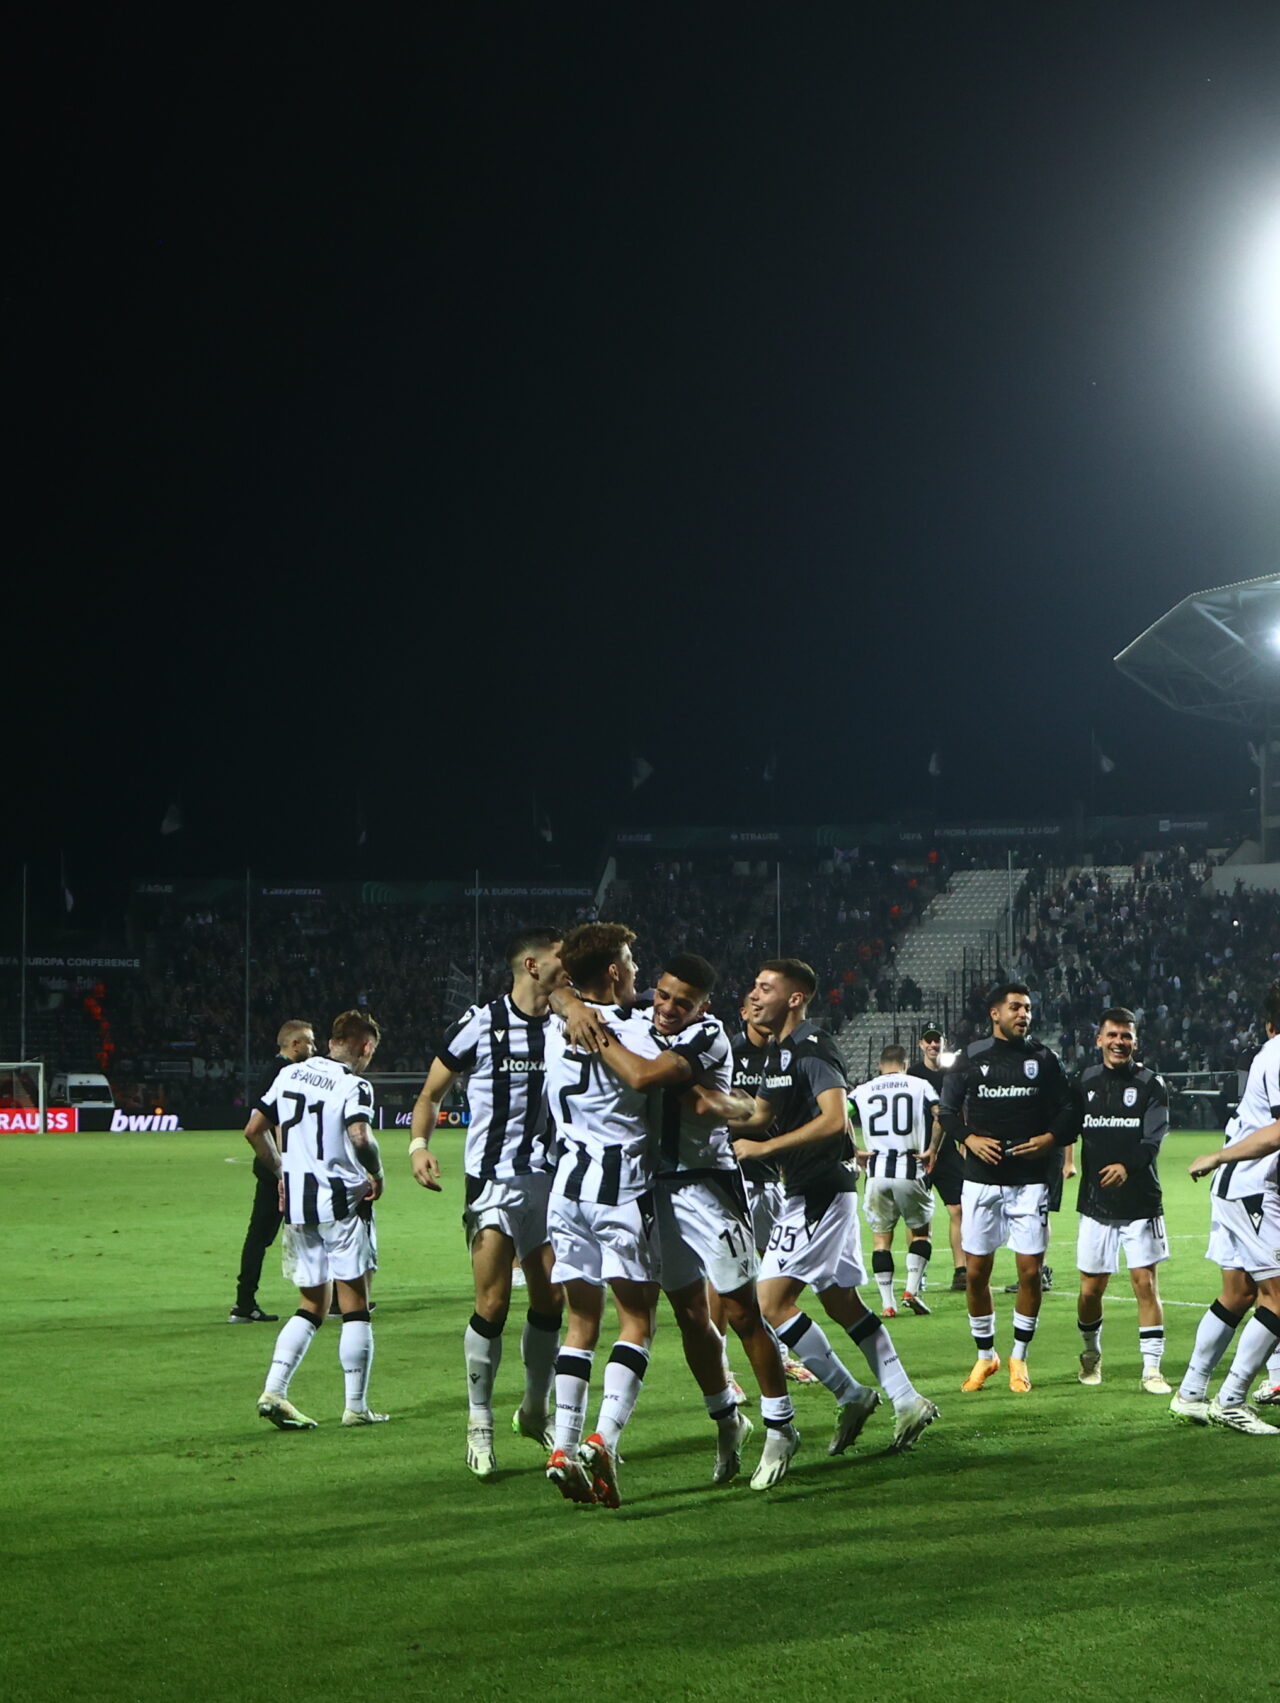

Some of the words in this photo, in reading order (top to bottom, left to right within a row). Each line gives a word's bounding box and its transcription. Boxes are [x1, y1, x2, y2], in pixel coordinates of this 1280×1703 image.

[66, 957, 141, 968] CONFERENCE
[499, 1059, 547, 1072] Stoixi
[110, 1107, 180, 1132] bwin
[281, 1090, 325, 1160] 71
[868, 1093, 913, 1136] 20
[1082, 1113, 1141, 1129] Stoiximan
[718, 1223, 747, 1259] 11
[768, 1224, 798, 1253] 95
